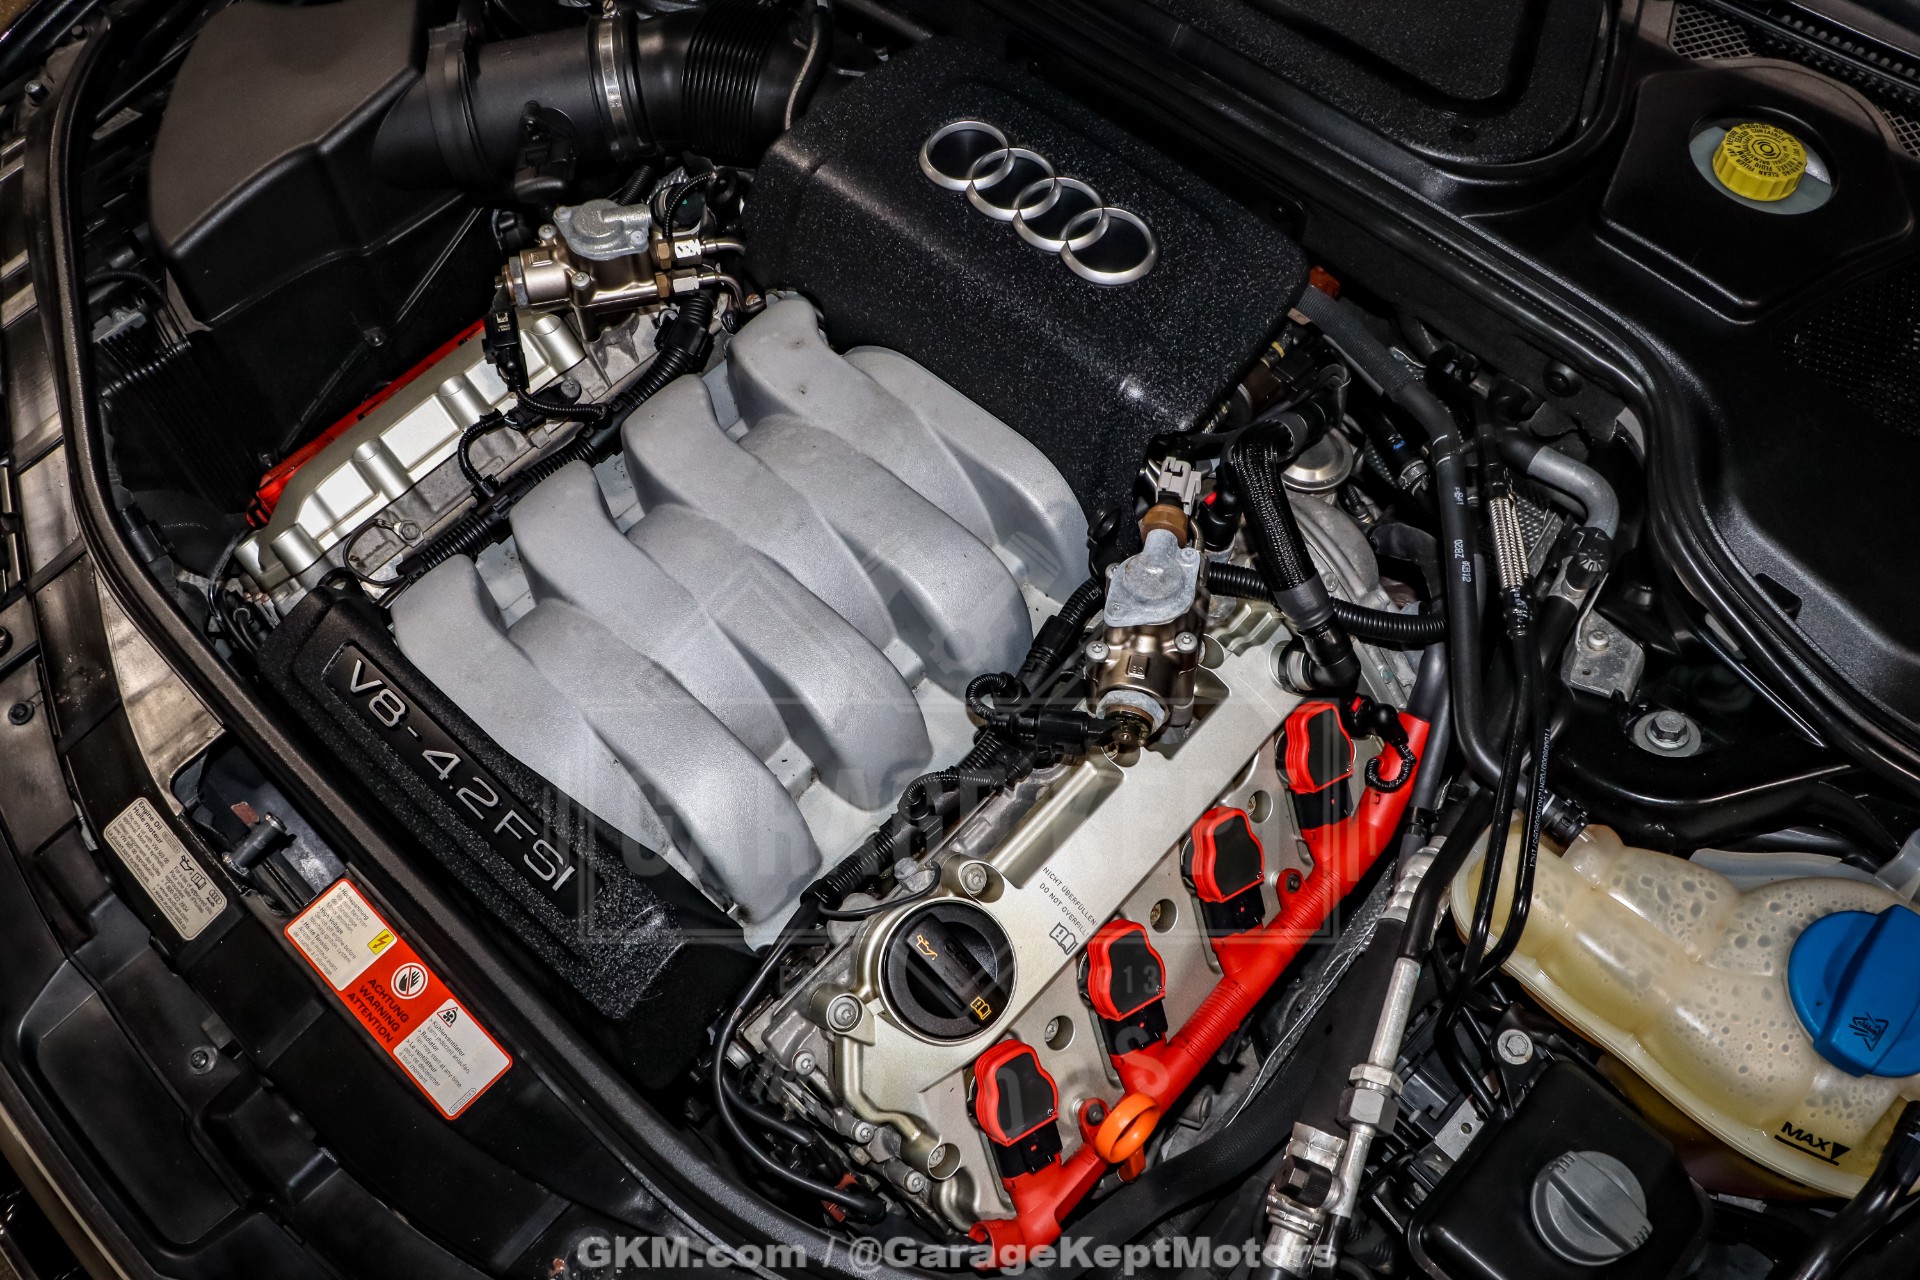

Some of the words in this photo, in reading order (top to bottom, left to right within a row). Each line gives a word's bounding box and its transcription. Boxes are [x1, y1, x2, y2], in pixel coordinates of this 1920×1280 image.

[1750, 128, 1785, 141] CONTAINER
[1727, 148, 1737, 157] CAP
[1736, 150, 1752, 164] FROM
[1736, 158, 1755, 172] FILLER
[1754, 162, 1773, 172] FLUID
[1758, 169, 1779, 177] CLEAN
[350, 658, 406, 728] V8
[132, 806, 145, 822] Huile
[144, 821, 162, 843] moteur
[137, 801, 154, 822] Engine
[153, 820, 162, 830] Oil
[132, 820, 141, 830] only
[151, 842, 159, 851] VW
[136, 832, 146, 844] Most
[150, 862, 161, 876] huiles
[169, 869, 178, 880] Pour
[176, 880, 184, 889] une
[183, 887, 191, 897] liste
[189, 887, 207, 907] approved
[205, 896, 215, 907] Audi
[340, 888, 369, 920] Hochspannung
[342, 900, 352, 910] dem
[1039, 882, 1049, 893] DO
[1048, 892, 1062, 906] NOT
[1061, 906, 1089, 936] OVERFILL!
[1042, 866, 1062, 886] NICHT
[1061, 885, 1098, 926] ÜBERFÜLLEN!
[309, 916, 325, 935] touching
[323, 933, 338, 949] ignition
[314, 911, 328, 926] Switch
[331, 931, 344, 946] engine
[343, 944, 356, 959] before
[319, 907, 330, 919] High
[328, 916, 344, 934] Voltage
[302, 921, 316, 935] Haute
[314, 933, 330, 951] Tension
[359, 985, 400, 1031] WARNING
[367, 978, 409, 1023] ACHTUNG
[347, 992, 393, 1042] ATTENTION
[420, 1030, 439, 1051] Radiator
[432, 1020, 465, 1056] Kühlerventilator
[401, 1054, 411, 1065] tout
[408, 1041, 416, 1049] Le
[414, 1048, 437, 1073] ventilateur
[415, 1035, 423, 1044] fan
[421, 1043, 431, 1054] may
[430, 1053, 441, 1064] start
[443, 1068, 452, 1077] any
[1781, 1121, 1831, 1152] MAX
